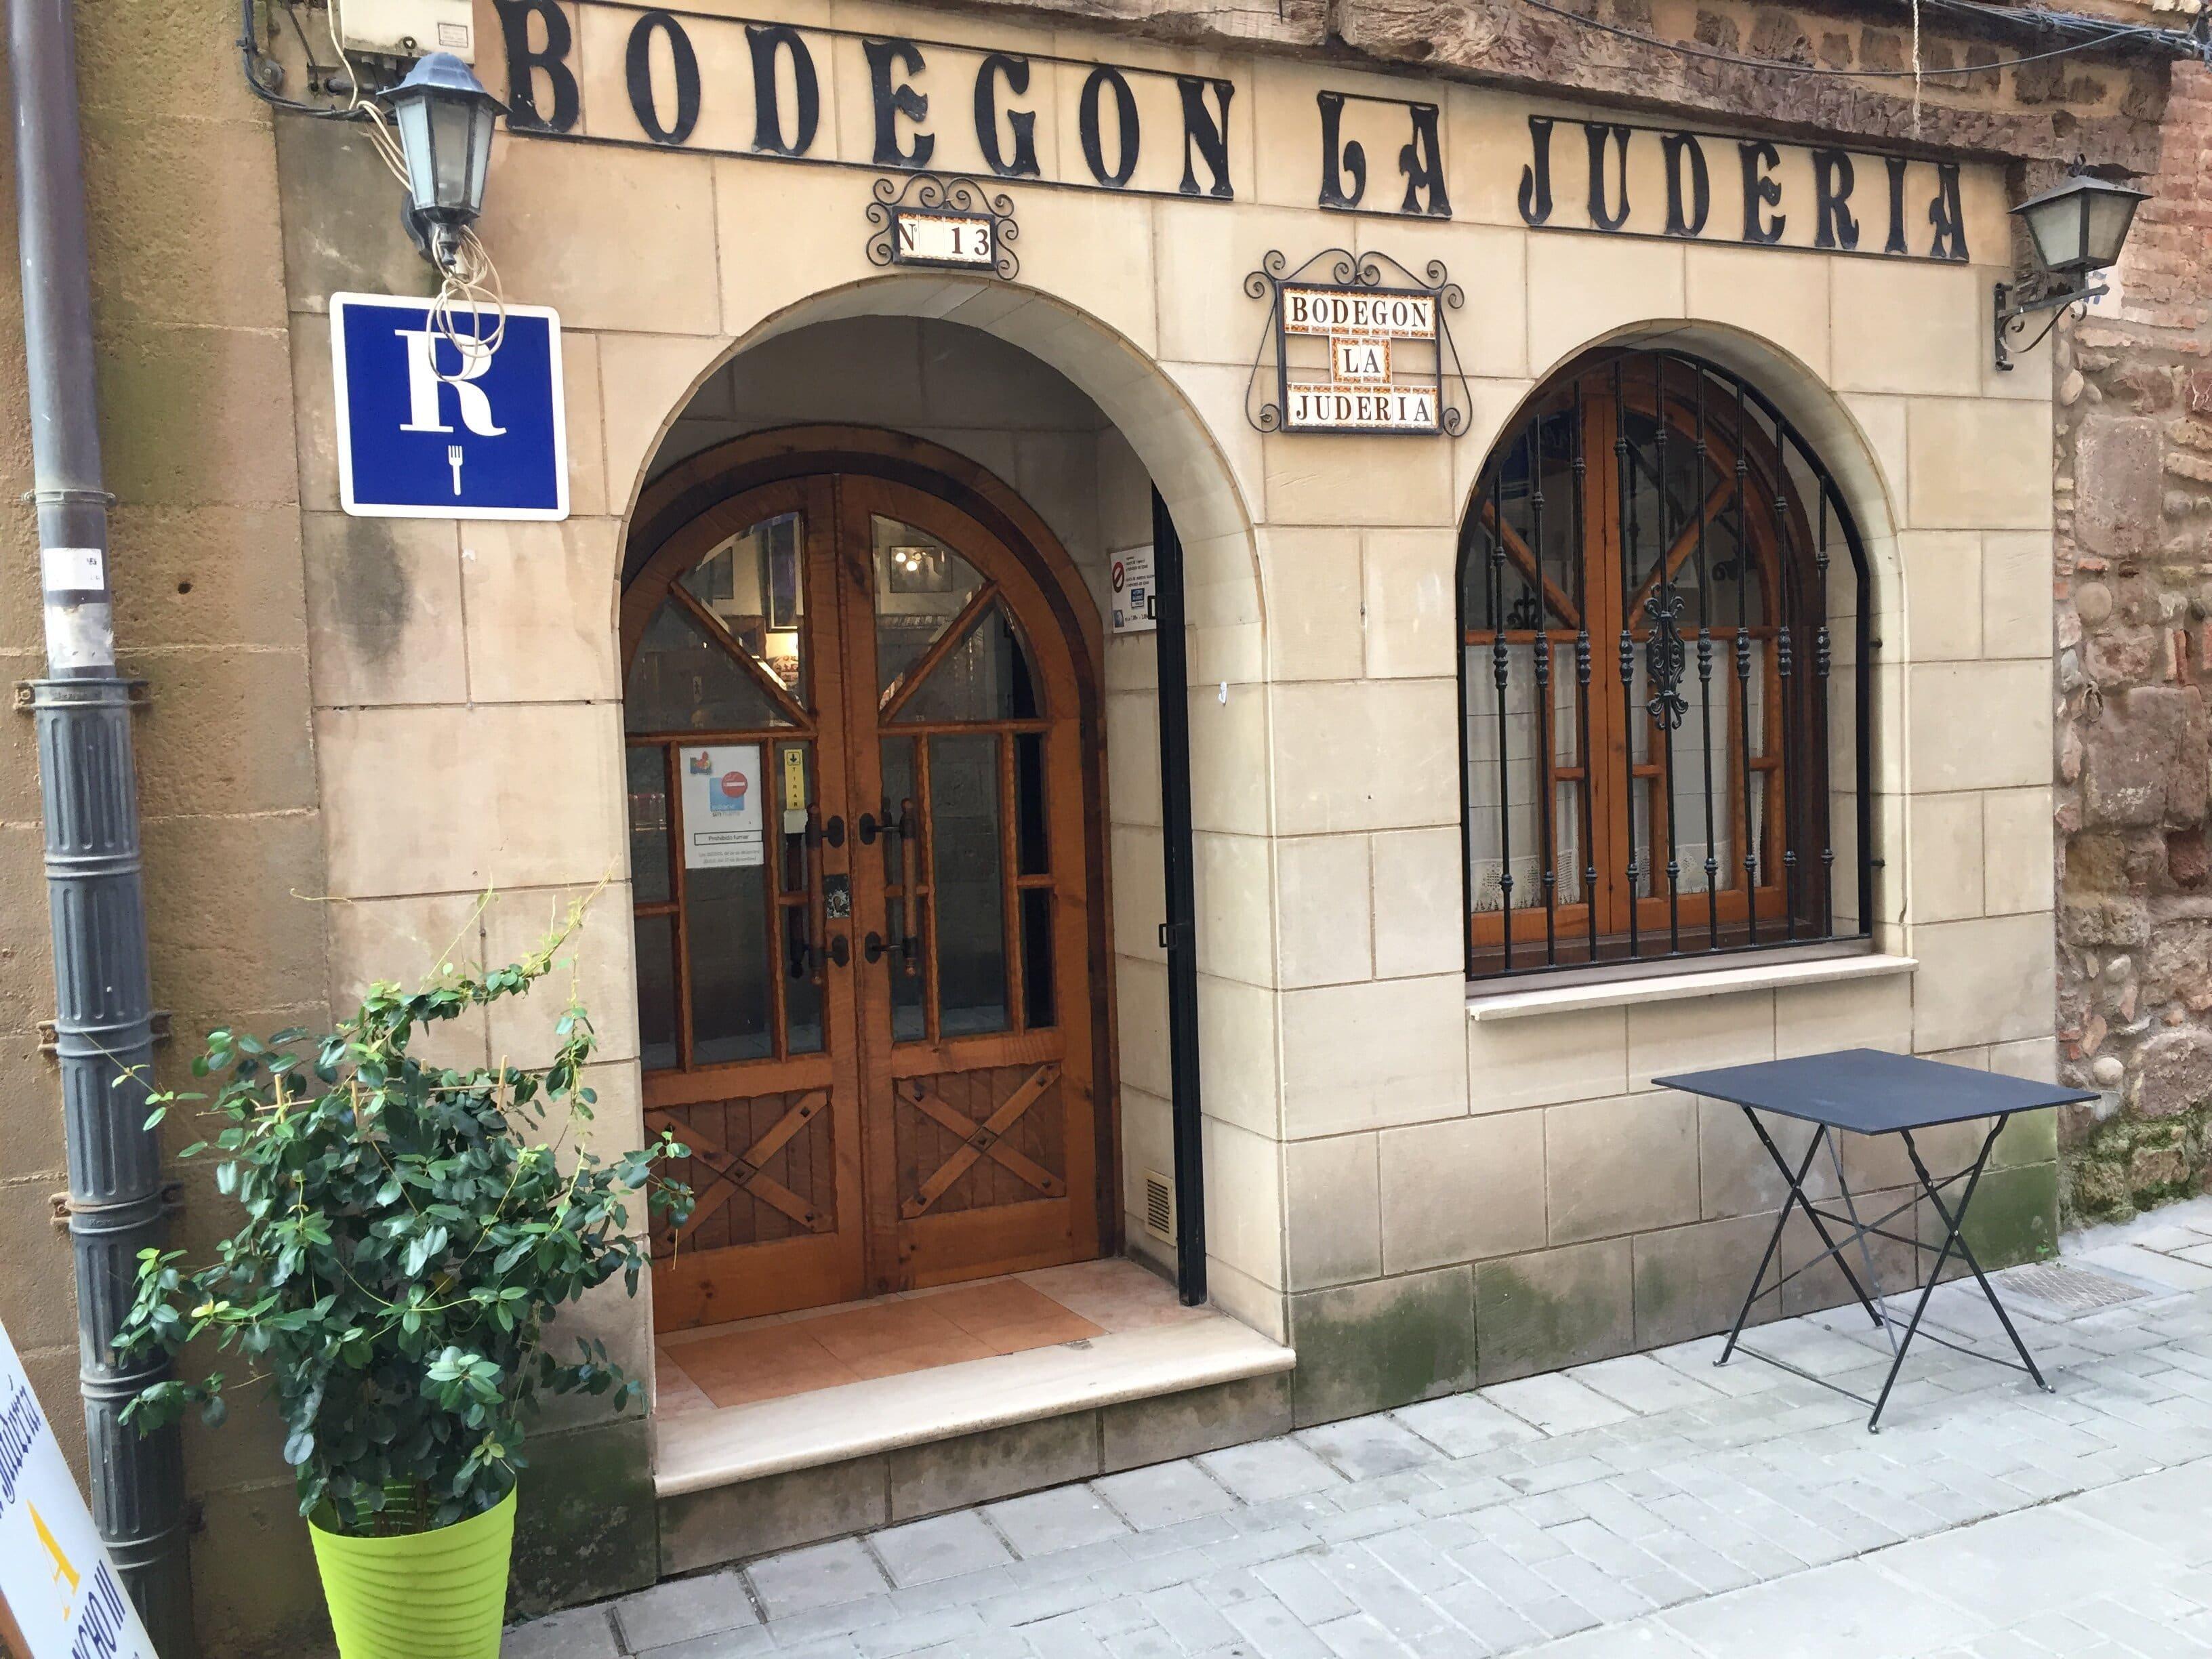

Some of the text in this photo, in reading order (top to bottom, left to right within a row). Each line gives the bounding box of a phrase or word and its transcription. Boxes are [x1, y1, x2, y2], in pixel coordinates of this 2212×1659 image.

[498, 0, 1969, 262] BODEGON LA JUDERIA
[951, 227, 989, 255] 13
[1292, 296, 1427, 327] BODEGON
[1343, 348, 1380, 373] LA
[394, 329, 507, 436] R
[1296, 395, 1431, 422] JUDERIA
